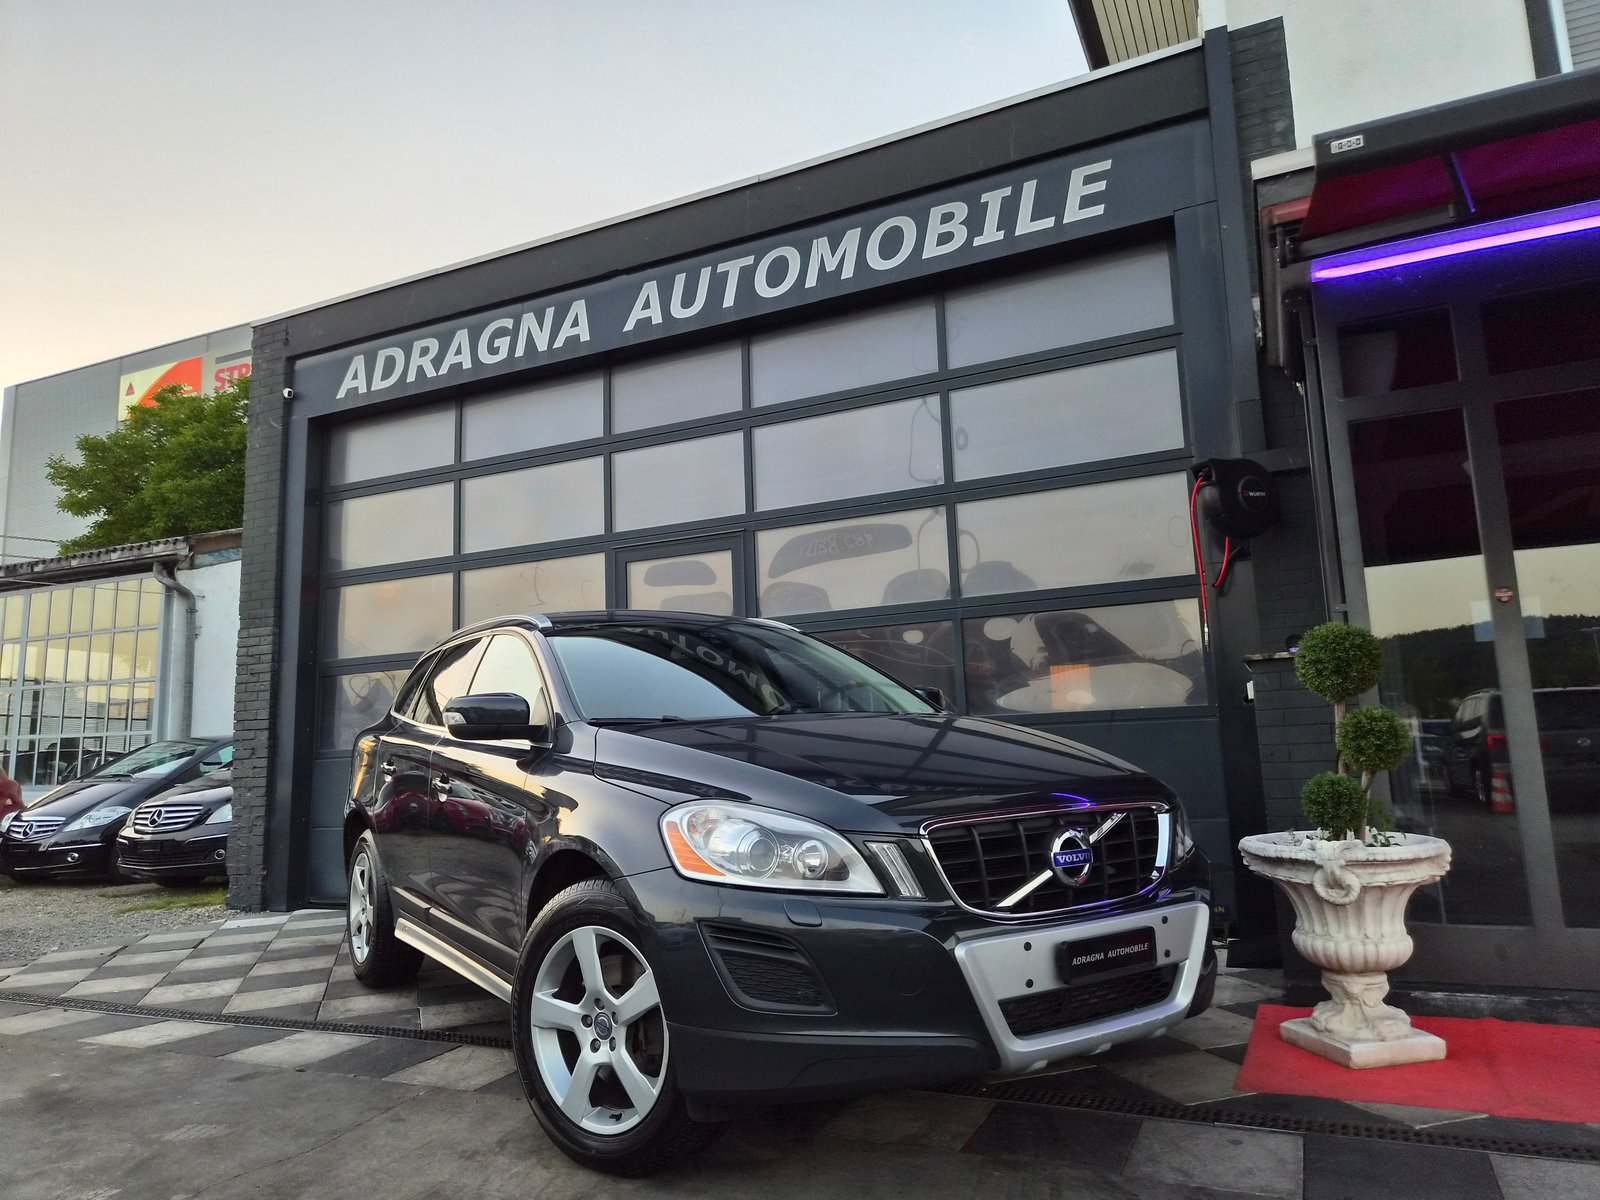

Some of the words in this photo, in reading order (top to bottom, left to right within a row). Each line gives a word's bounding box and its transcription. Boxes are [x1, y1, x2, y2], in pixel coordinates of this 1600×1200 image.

[336, 299, 591, 399] ADRAGNA
[622, 159, 1113, 332] AUTOMOBILE
[1056, 852, 1090, 863] VOLVO
[1072, 952, 1104, 966] ADRAGNA
[1107, 942, 1148, 957] AUTOMOBILE
